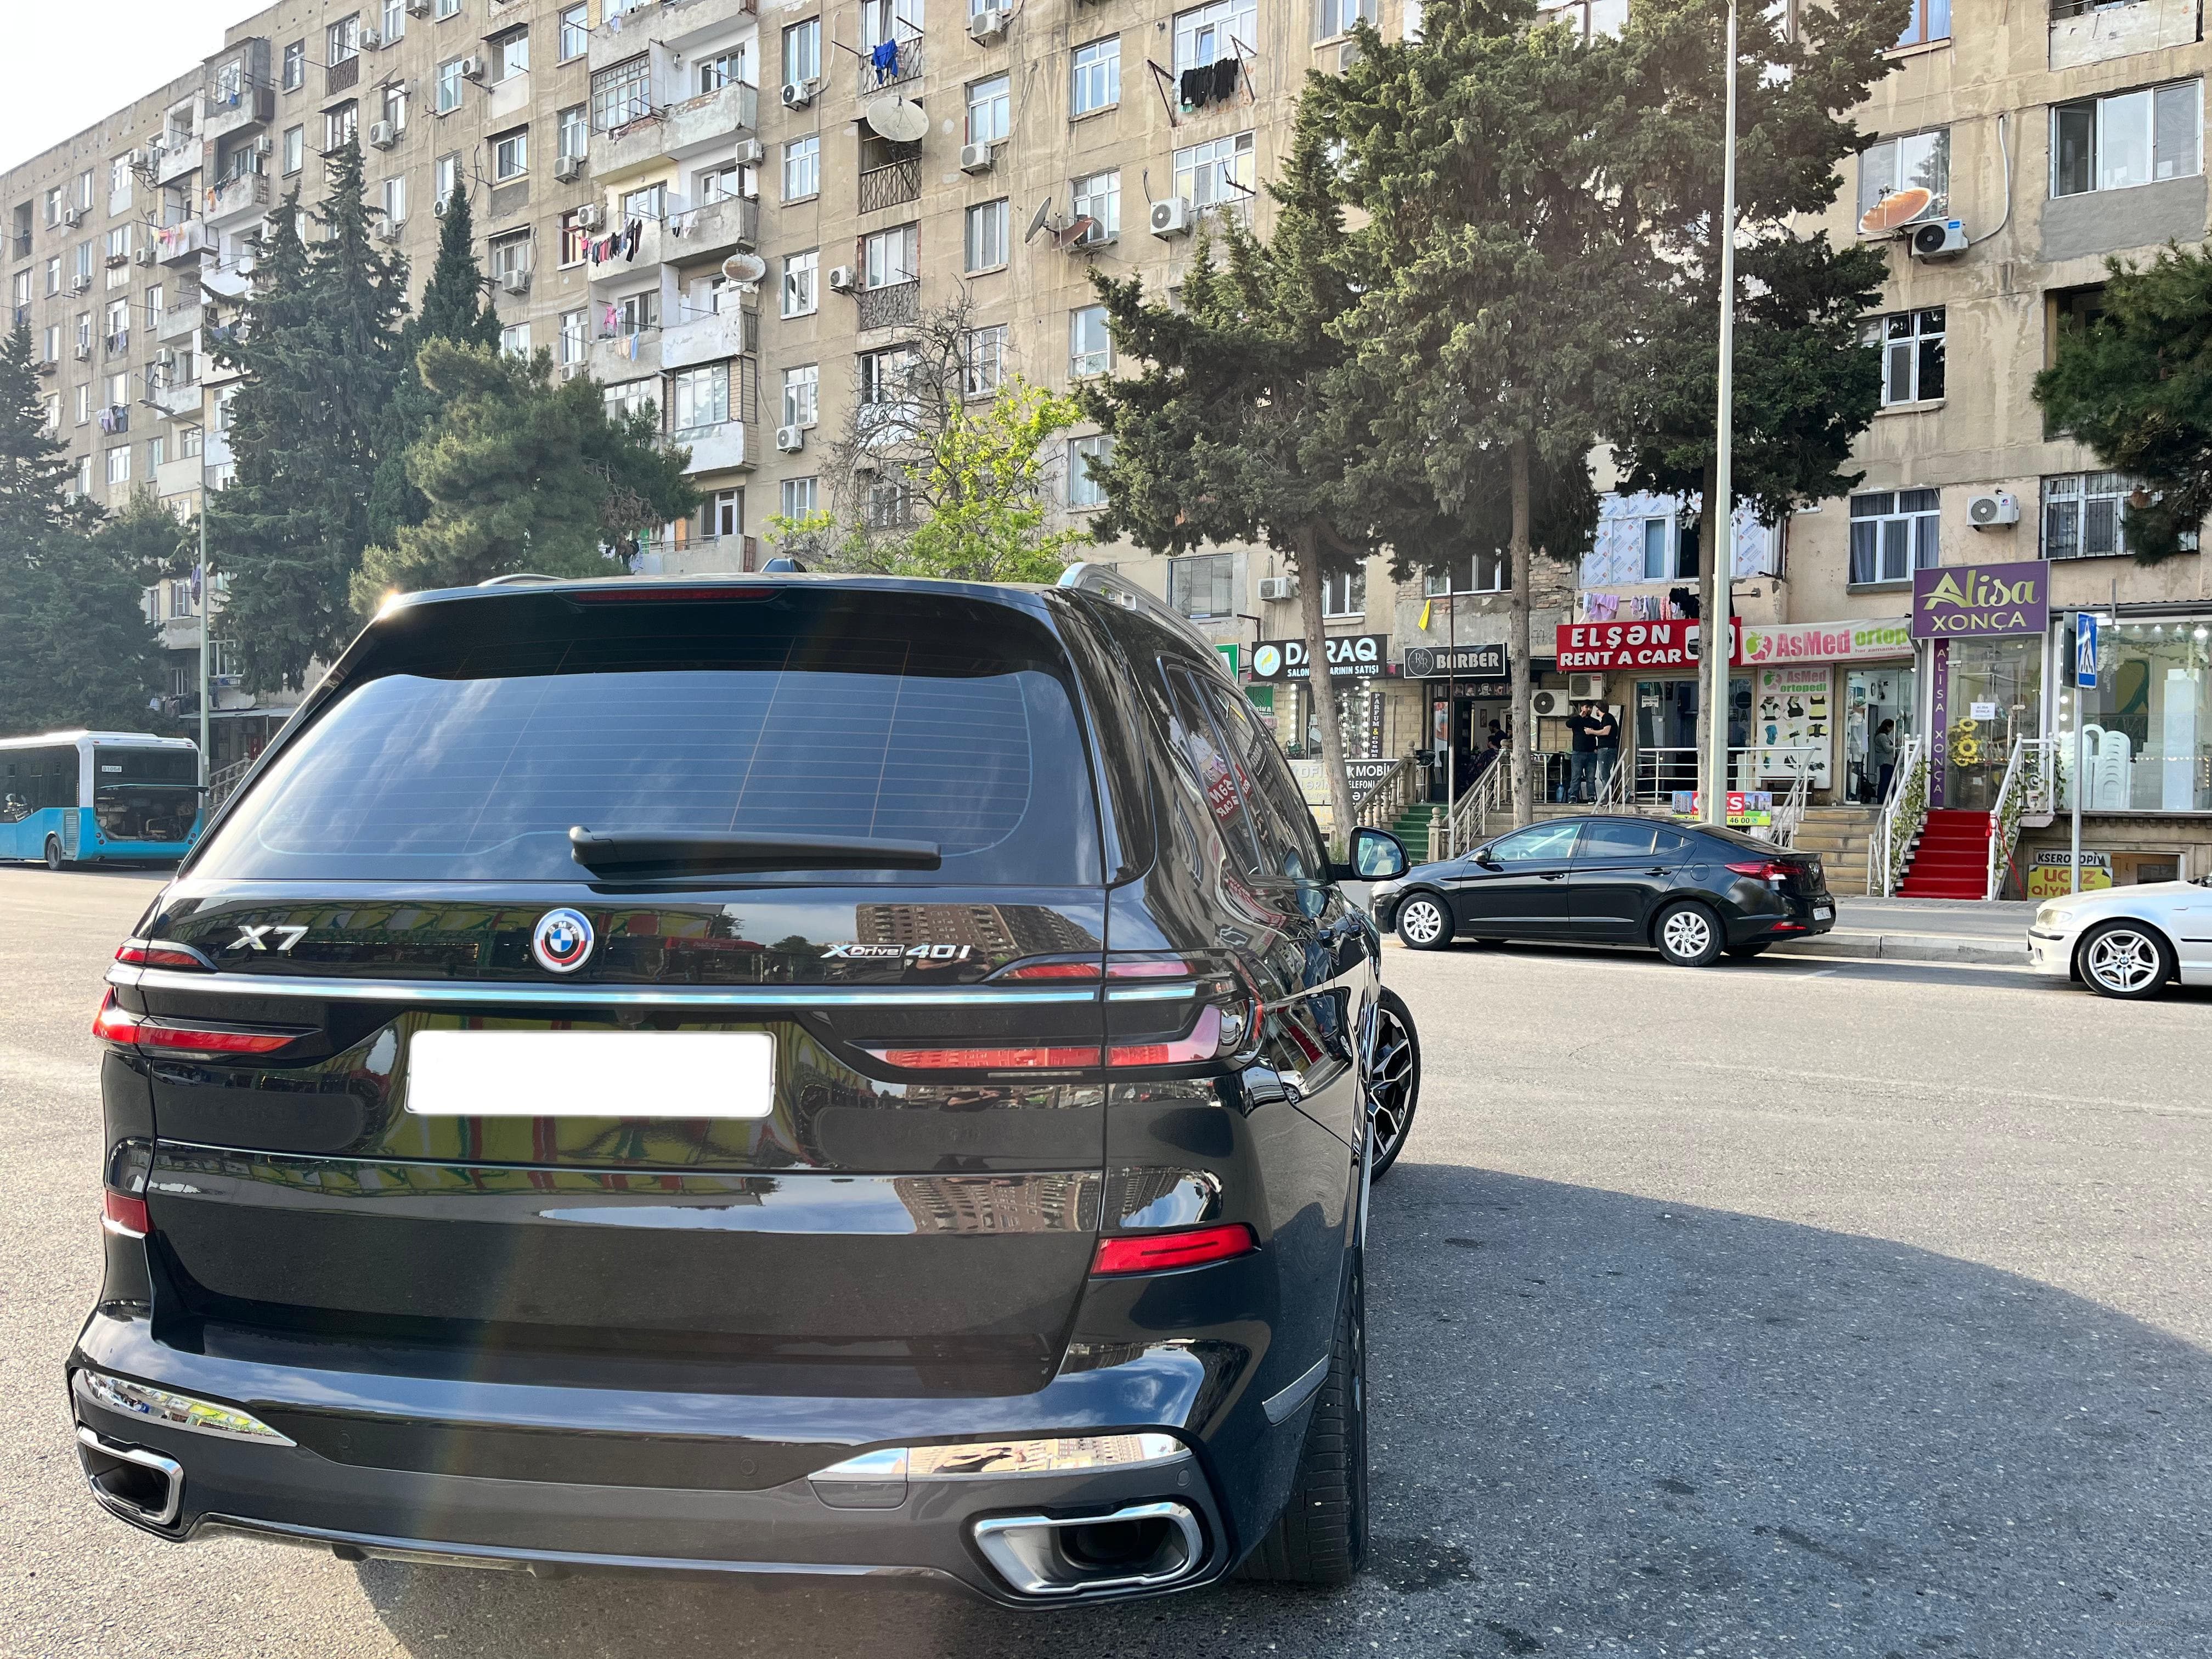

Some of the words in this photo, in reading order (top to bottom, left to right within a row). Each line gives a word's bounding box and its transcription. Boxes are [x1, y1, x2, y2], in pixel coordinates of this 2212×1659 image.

[1919, 570, 2040, 610] Alisa
[1931, 611, 2027, 631] XONÇA
[1571, 624, 1671, 649] ELŞƏN
[1776, 629, 1851, 657] AsMed
[1855, 627, 1908, 646] ortop
[1436, 652, 1499, 669] BARBER
[1560, 651, 1614, 667] RENT
[1618, 651, 1633, 665] A
[1638, 648, 1682, 664] CAR
[1287, 668, 1310, 677] SALON
[1330, 665, 1353, 675] ARININ
[1355, 664, 1379, 675] SATIŞI
[1786, 670, 1827, 683] AsMed
[1780, 683, 1827, 692] ortopedi
[1936, 649, 1946, 713] ALISA
[1372, 693, 1380, 727] PARFUM
[1933, 730, 1944, 793] XONÇA
[2038, 852, 2105, 865] KSEROOPİY
[225, 925, 309, 950] X7
[548, 921, 578, 935] BMW
